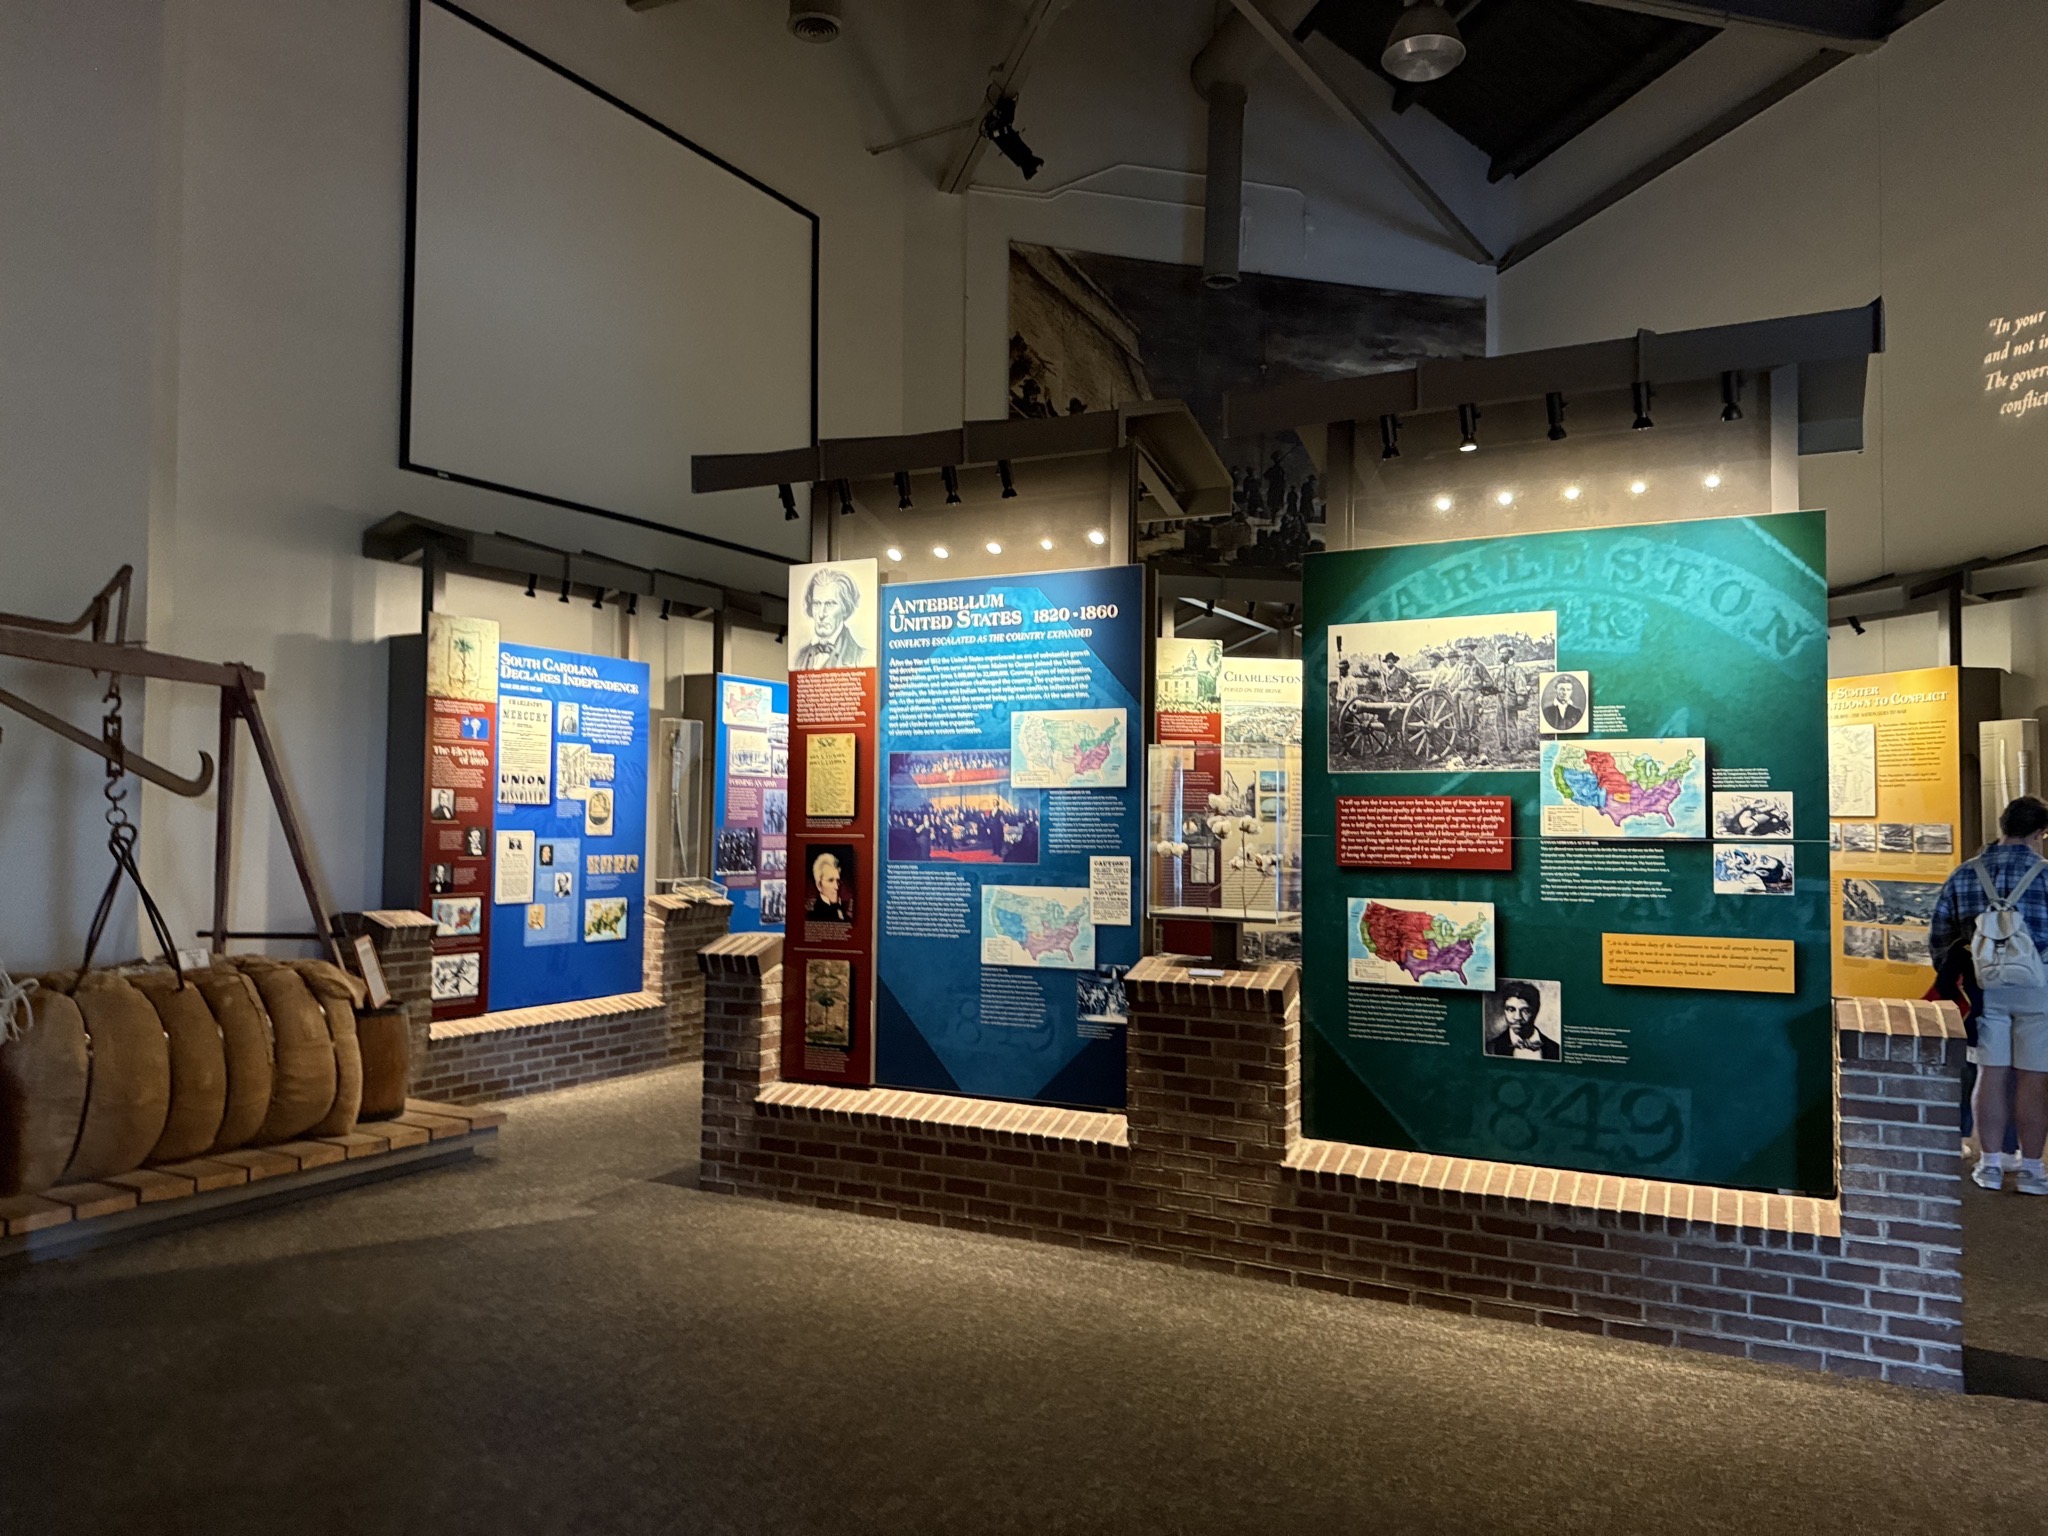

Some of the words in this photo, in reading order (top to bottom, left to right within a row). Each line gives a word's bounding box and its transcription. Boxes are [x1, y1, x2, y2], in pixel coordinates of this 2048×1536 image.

[2012, 310, 2047, 336] your
[1983, 340, 2011, 365] and
[2012, 339, 2035, 357] not
[1984, 369, 2010, 392] The
[889, 593, 1005, 615] ANTEBELLUM
[889, 613, 953, 633] UNITED
[956, 609, 1023, 629] STATES
[888, 637, 931, 650] CONFLICTS
[931, 634, 976, 647] ESCALATED
[976, 634, 988, 643] AS
[988, 632, 1005, 643] THE
[1005, 630, 1046, 643] COUNTRY
[1046, 627, 1093, 640] EXPANDED
[500, 651, 542, 670] SOUTH
[542, 657, 599, 678] CAROLINA
[500, 665, 561, 685] DECLARES
[562, 672, 640, 695] INDEPENDENCE
[1874, 697, 1889, 708] TO
[1890, 692, 1948, 706] CONFLICT
[503, 709, 548, 722] MERCURY
[501, 775, 546, 785] UNION
